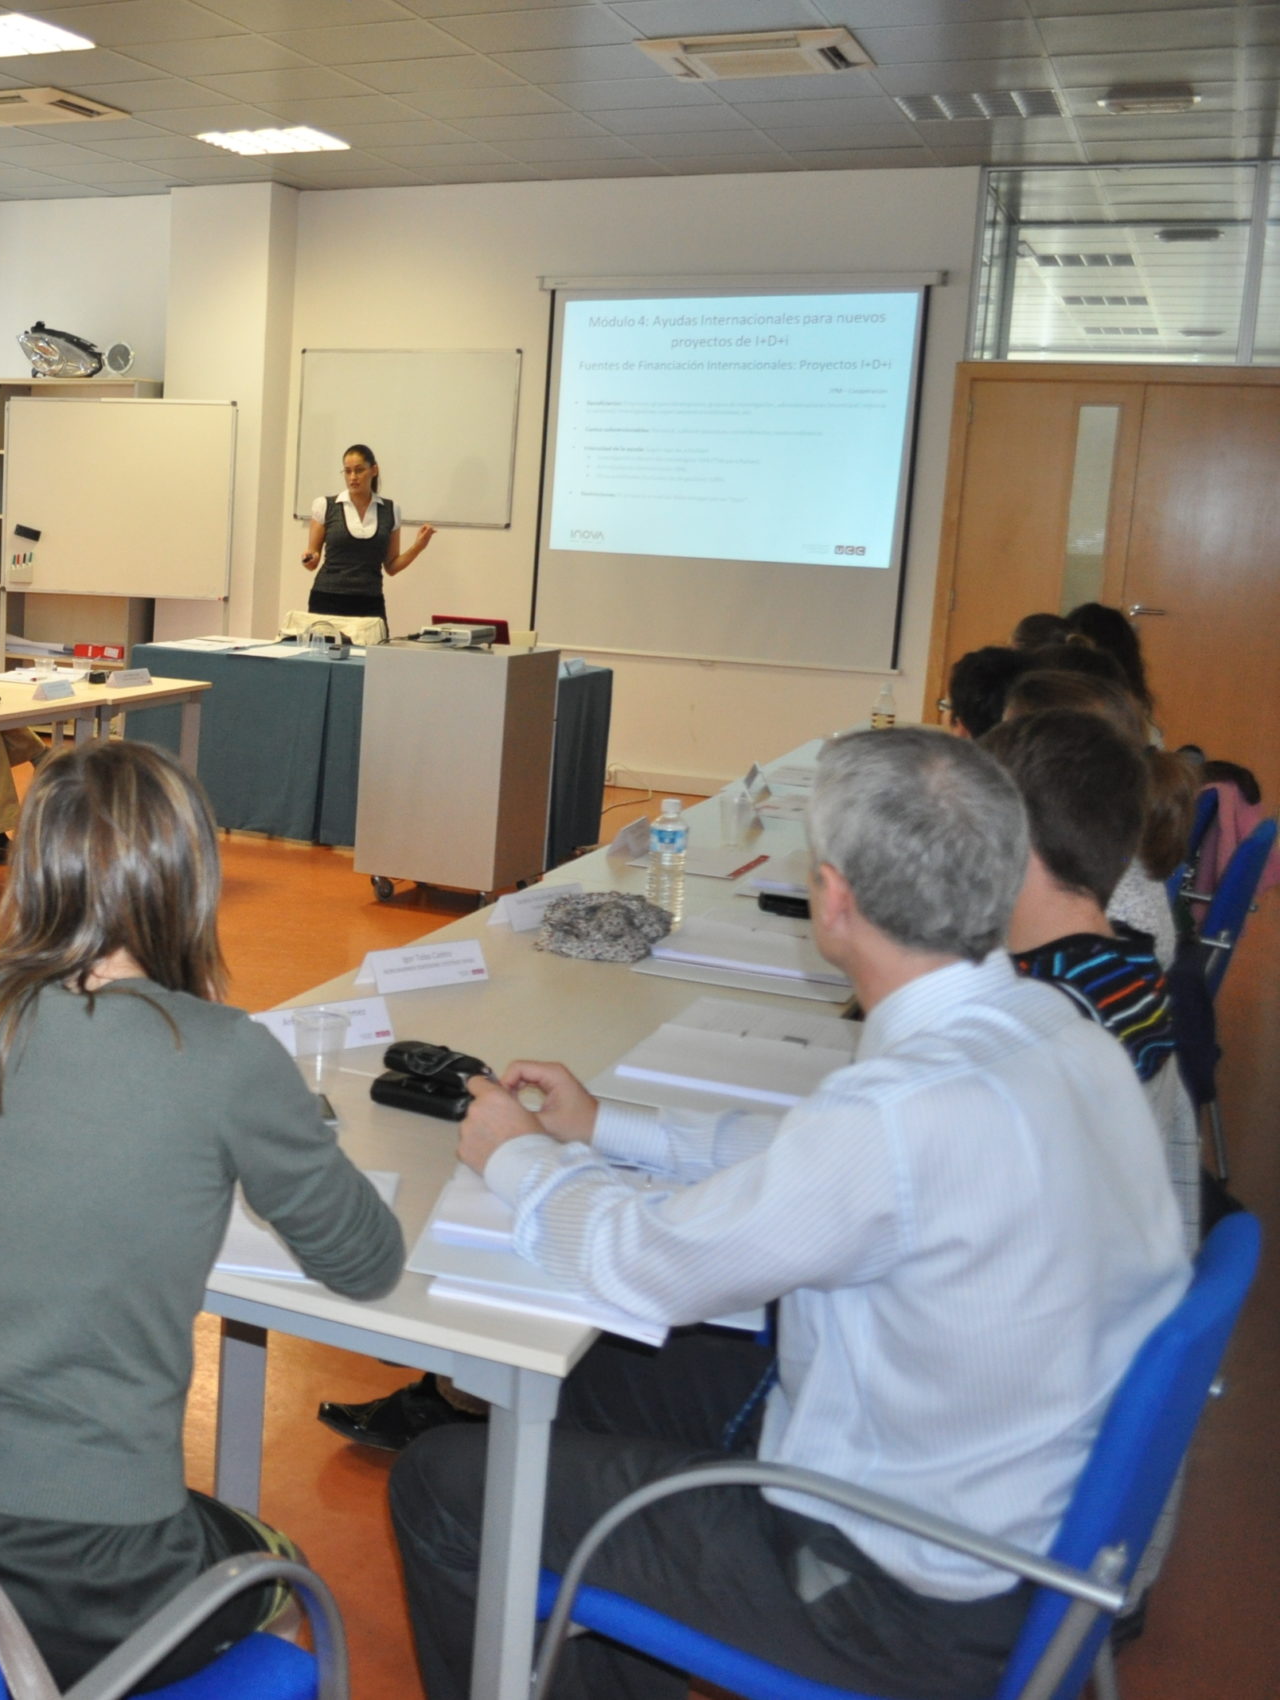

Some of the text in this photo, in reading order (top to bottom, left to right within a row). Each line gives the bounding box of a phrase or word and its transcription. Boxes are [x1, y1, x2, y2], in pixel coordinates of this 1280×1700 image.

[588, 312, 887, 329] Módulo 4: Ayudas Internacionales para nuevos
[671, 334, 789, 350] proyectos de I+D+i
[579, 359, 892, 373] Fuentes de Financiación Internacionales: Proyectos I+D+i
